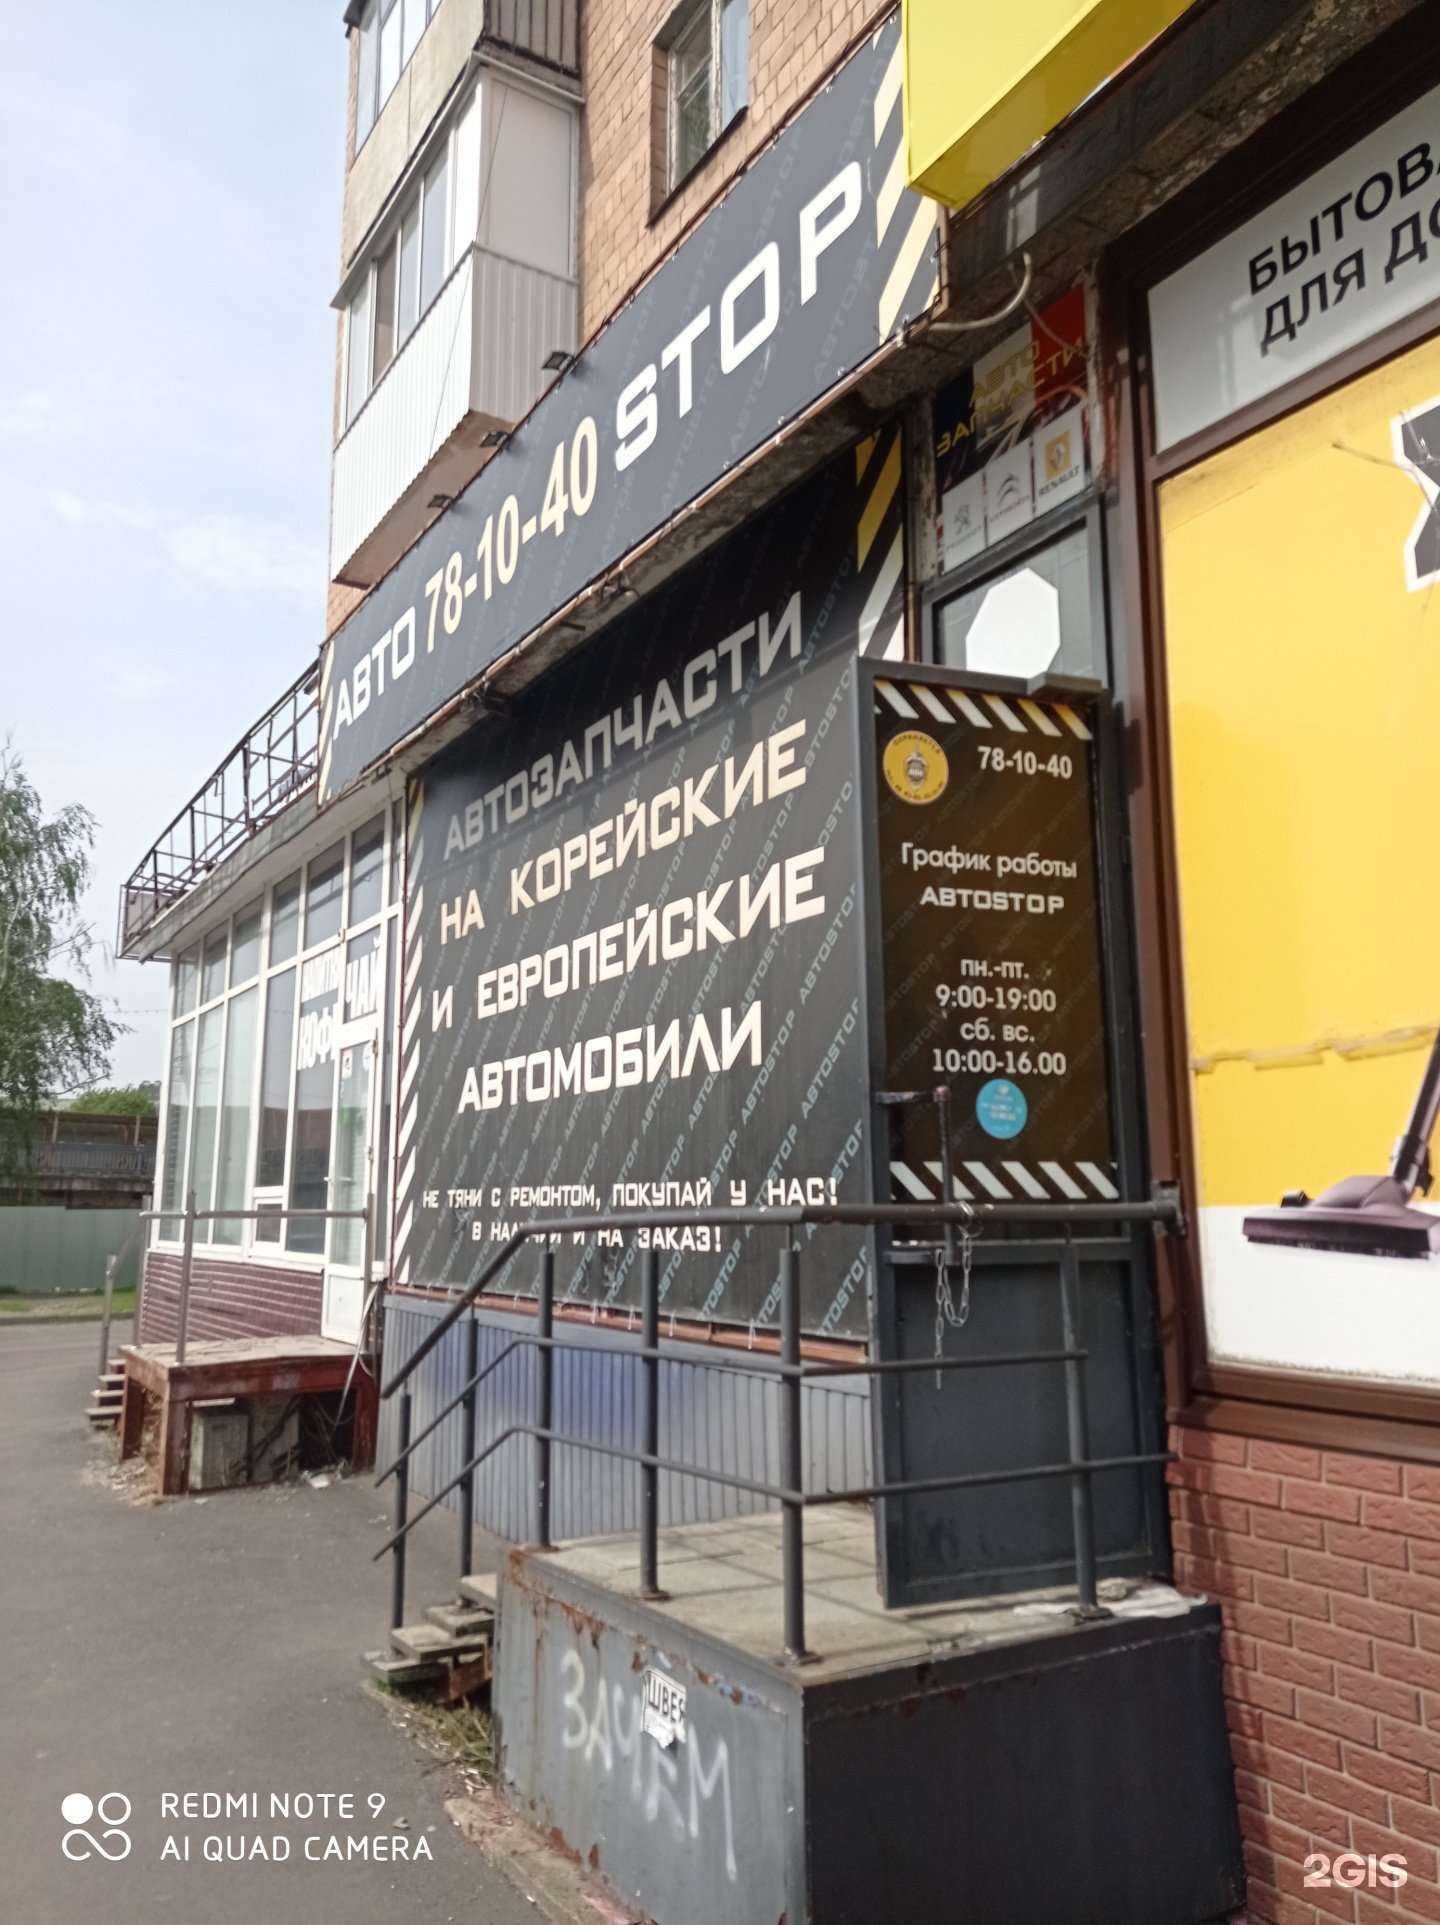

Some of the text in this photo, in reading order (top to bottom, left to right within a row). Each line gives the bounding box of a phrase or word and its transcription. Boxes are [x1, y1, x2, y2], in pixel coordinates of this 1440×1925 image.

[1249, 142, 1440, 295] БЫТОВ
[1261, 249, 1365, 357] ДЛЯ
[333, 607, 415, 740] АВТО
[425, 416, 597, 653] 78-10-40
[615, 161, 863, 472] STOP
[443, 592, 801, 860] АВТОЗАПЧАСТИ
[978, 745, 1073, 780] 78-10-40
[440, 889, 485, 945] НА
[511, 719, 807, 915] КОРЕЙСКИЕ
[901, 842, 1078, 878] График работы
[919, 885, 1065, 915] АВТОSTOP
[432, 985, 453, 1033] И
[477, 846, 826, 1019] ЕВРОПЕЙСКИЕ
[960, 958, 1030, 979] пн.-пт.
[935, 983, 1058, 1012] 9:00-19:00
[960, 1017, 1036, 1043] сб. вс.
[458, 1000, 762, 1114] АВТОМОБИЛИ
[932, 1047, 1068, 1076] 10:00-16.00
[423, 1176, 838, 1212] НЕ ТЯНИ С РЕМОНТОМ, ПОКУПАЙ У НАС!
[471, 1221, 482, 1241] В
[598, 1229, 624, 1248] НА
[638, 1226, 722, 1252] ЗАКАЗ!
